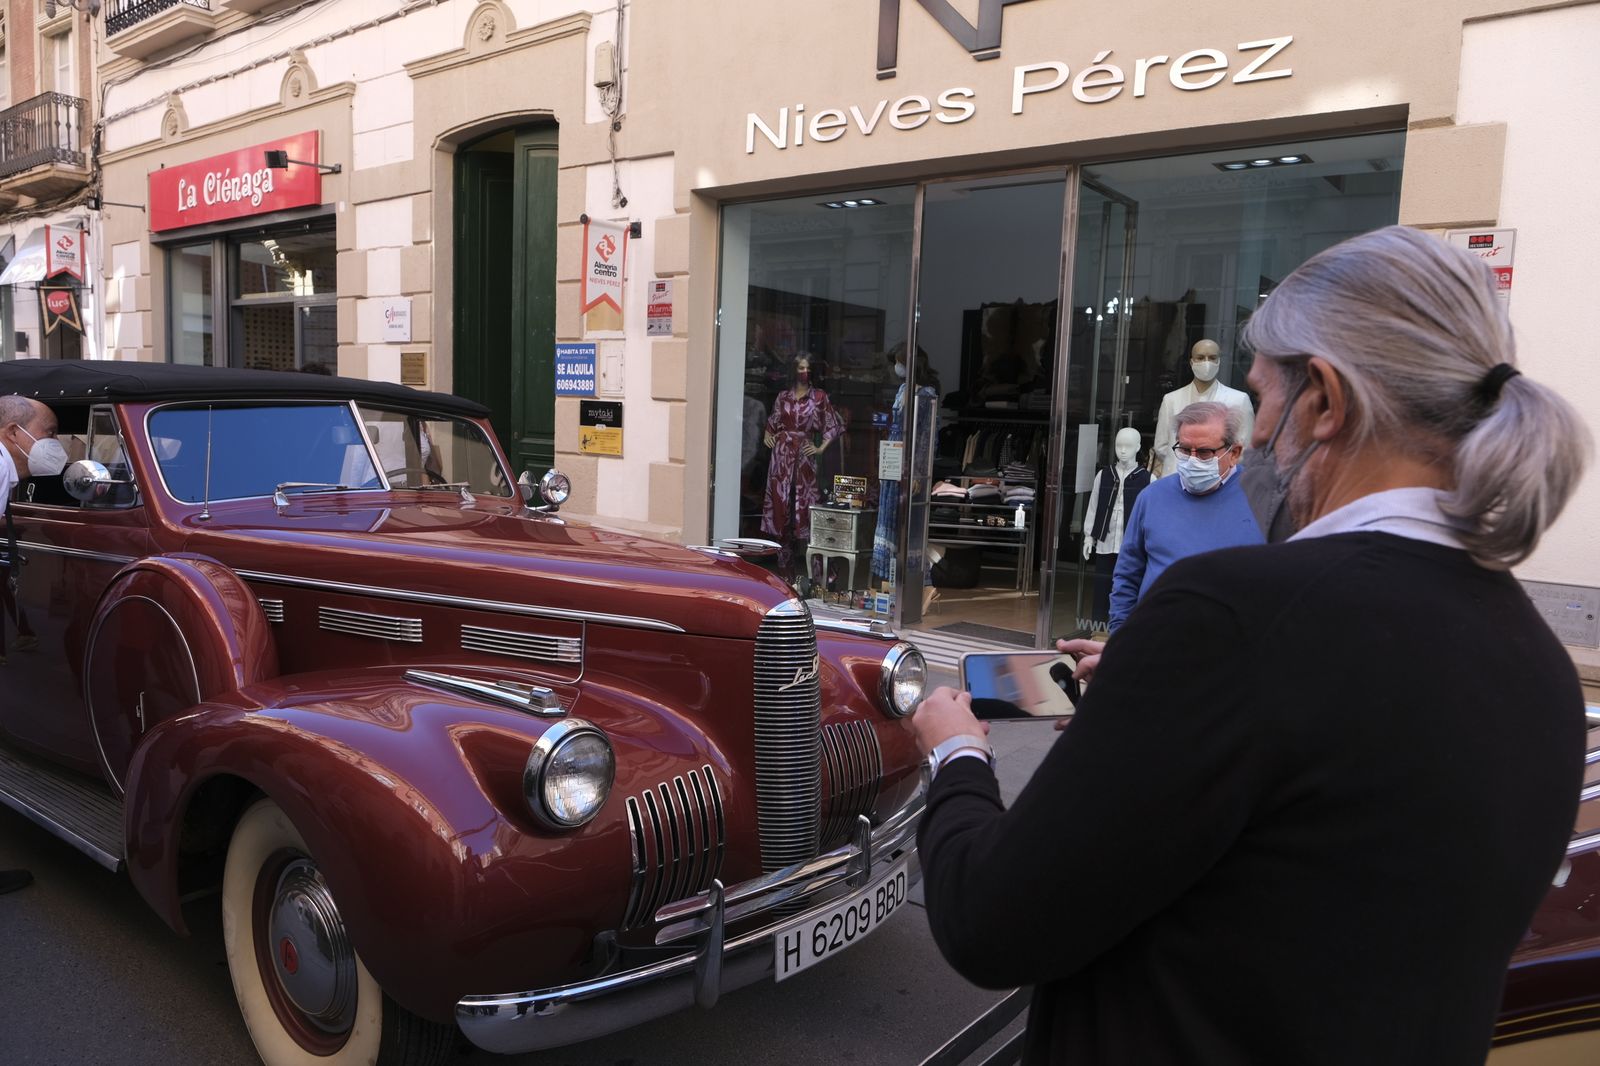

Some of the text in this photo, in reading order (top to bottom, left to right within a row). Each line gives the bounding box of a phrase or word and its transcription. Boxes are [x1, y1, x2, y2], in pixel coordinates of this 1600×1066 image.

[745, 35, 1293, 154] Nieves Pérez
[177, 167, 274, 212] La Ciénaga
[594, 268, 617, 278] centro
[590, 277, 605, 286] NIEVES
[48, 299, 70, 308] luca
[557, 363, 594, 376] SE ALQUILA
[557, 379, 594, 391] 606943889
[784, 871, 905, 973] H 6209 BBD
